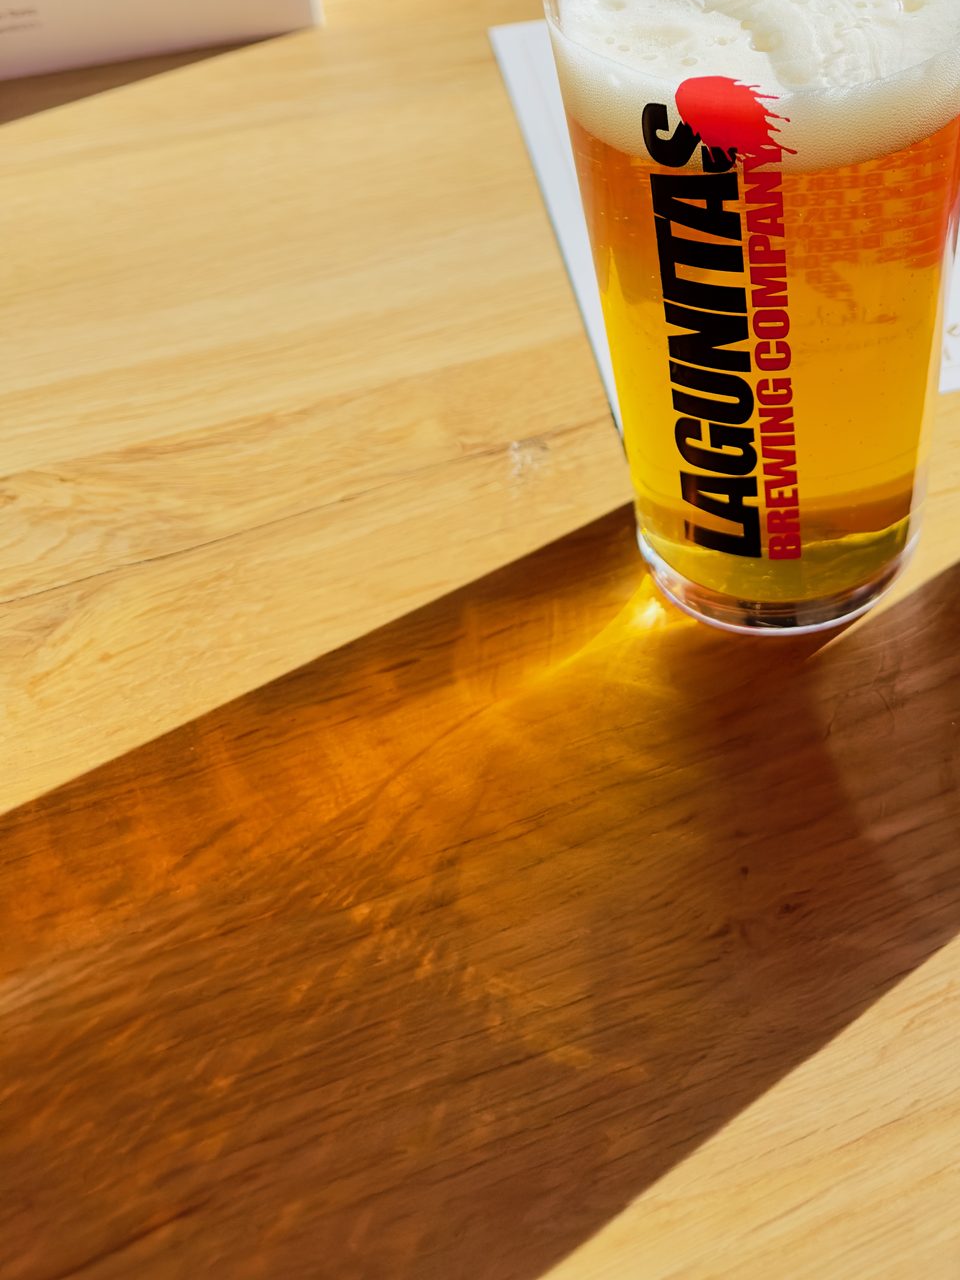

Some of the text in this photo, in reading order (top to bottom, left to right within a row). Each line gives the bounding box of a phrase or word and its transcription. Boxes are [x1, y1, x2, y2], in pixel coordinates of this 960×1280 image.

[642, 102, 763, 558] LAGUNITAS
[743, 146, 802, 560] BREWING COMPANY
